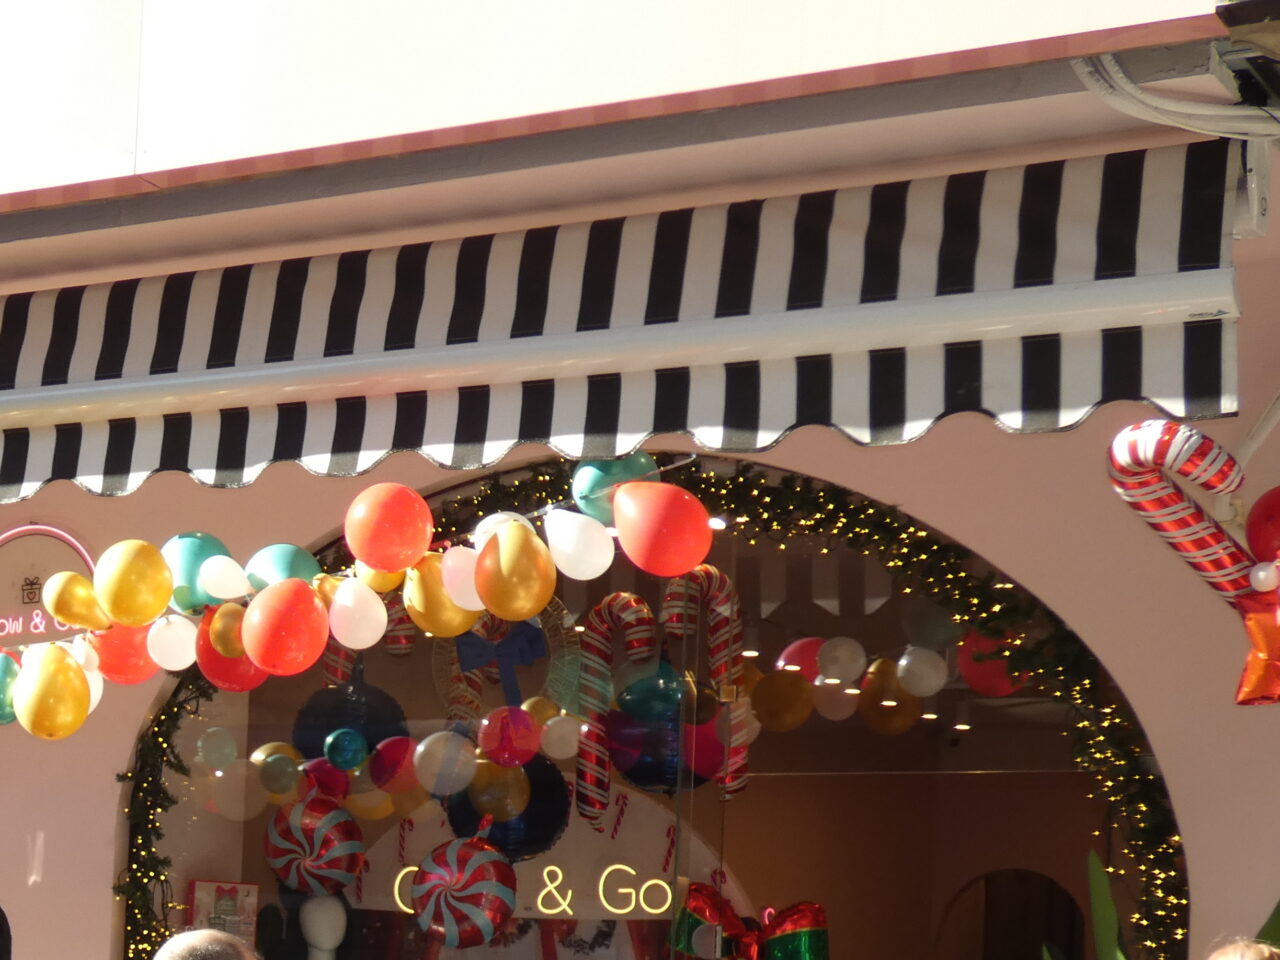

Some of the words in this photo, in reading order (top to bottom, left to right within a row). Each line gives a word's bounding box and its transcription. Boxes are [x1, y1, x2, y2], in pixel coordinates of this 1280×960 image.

[30, 610, 46, 633] &
[537, 865, 573, 915] &
[599, 864, 672, 914] Go
